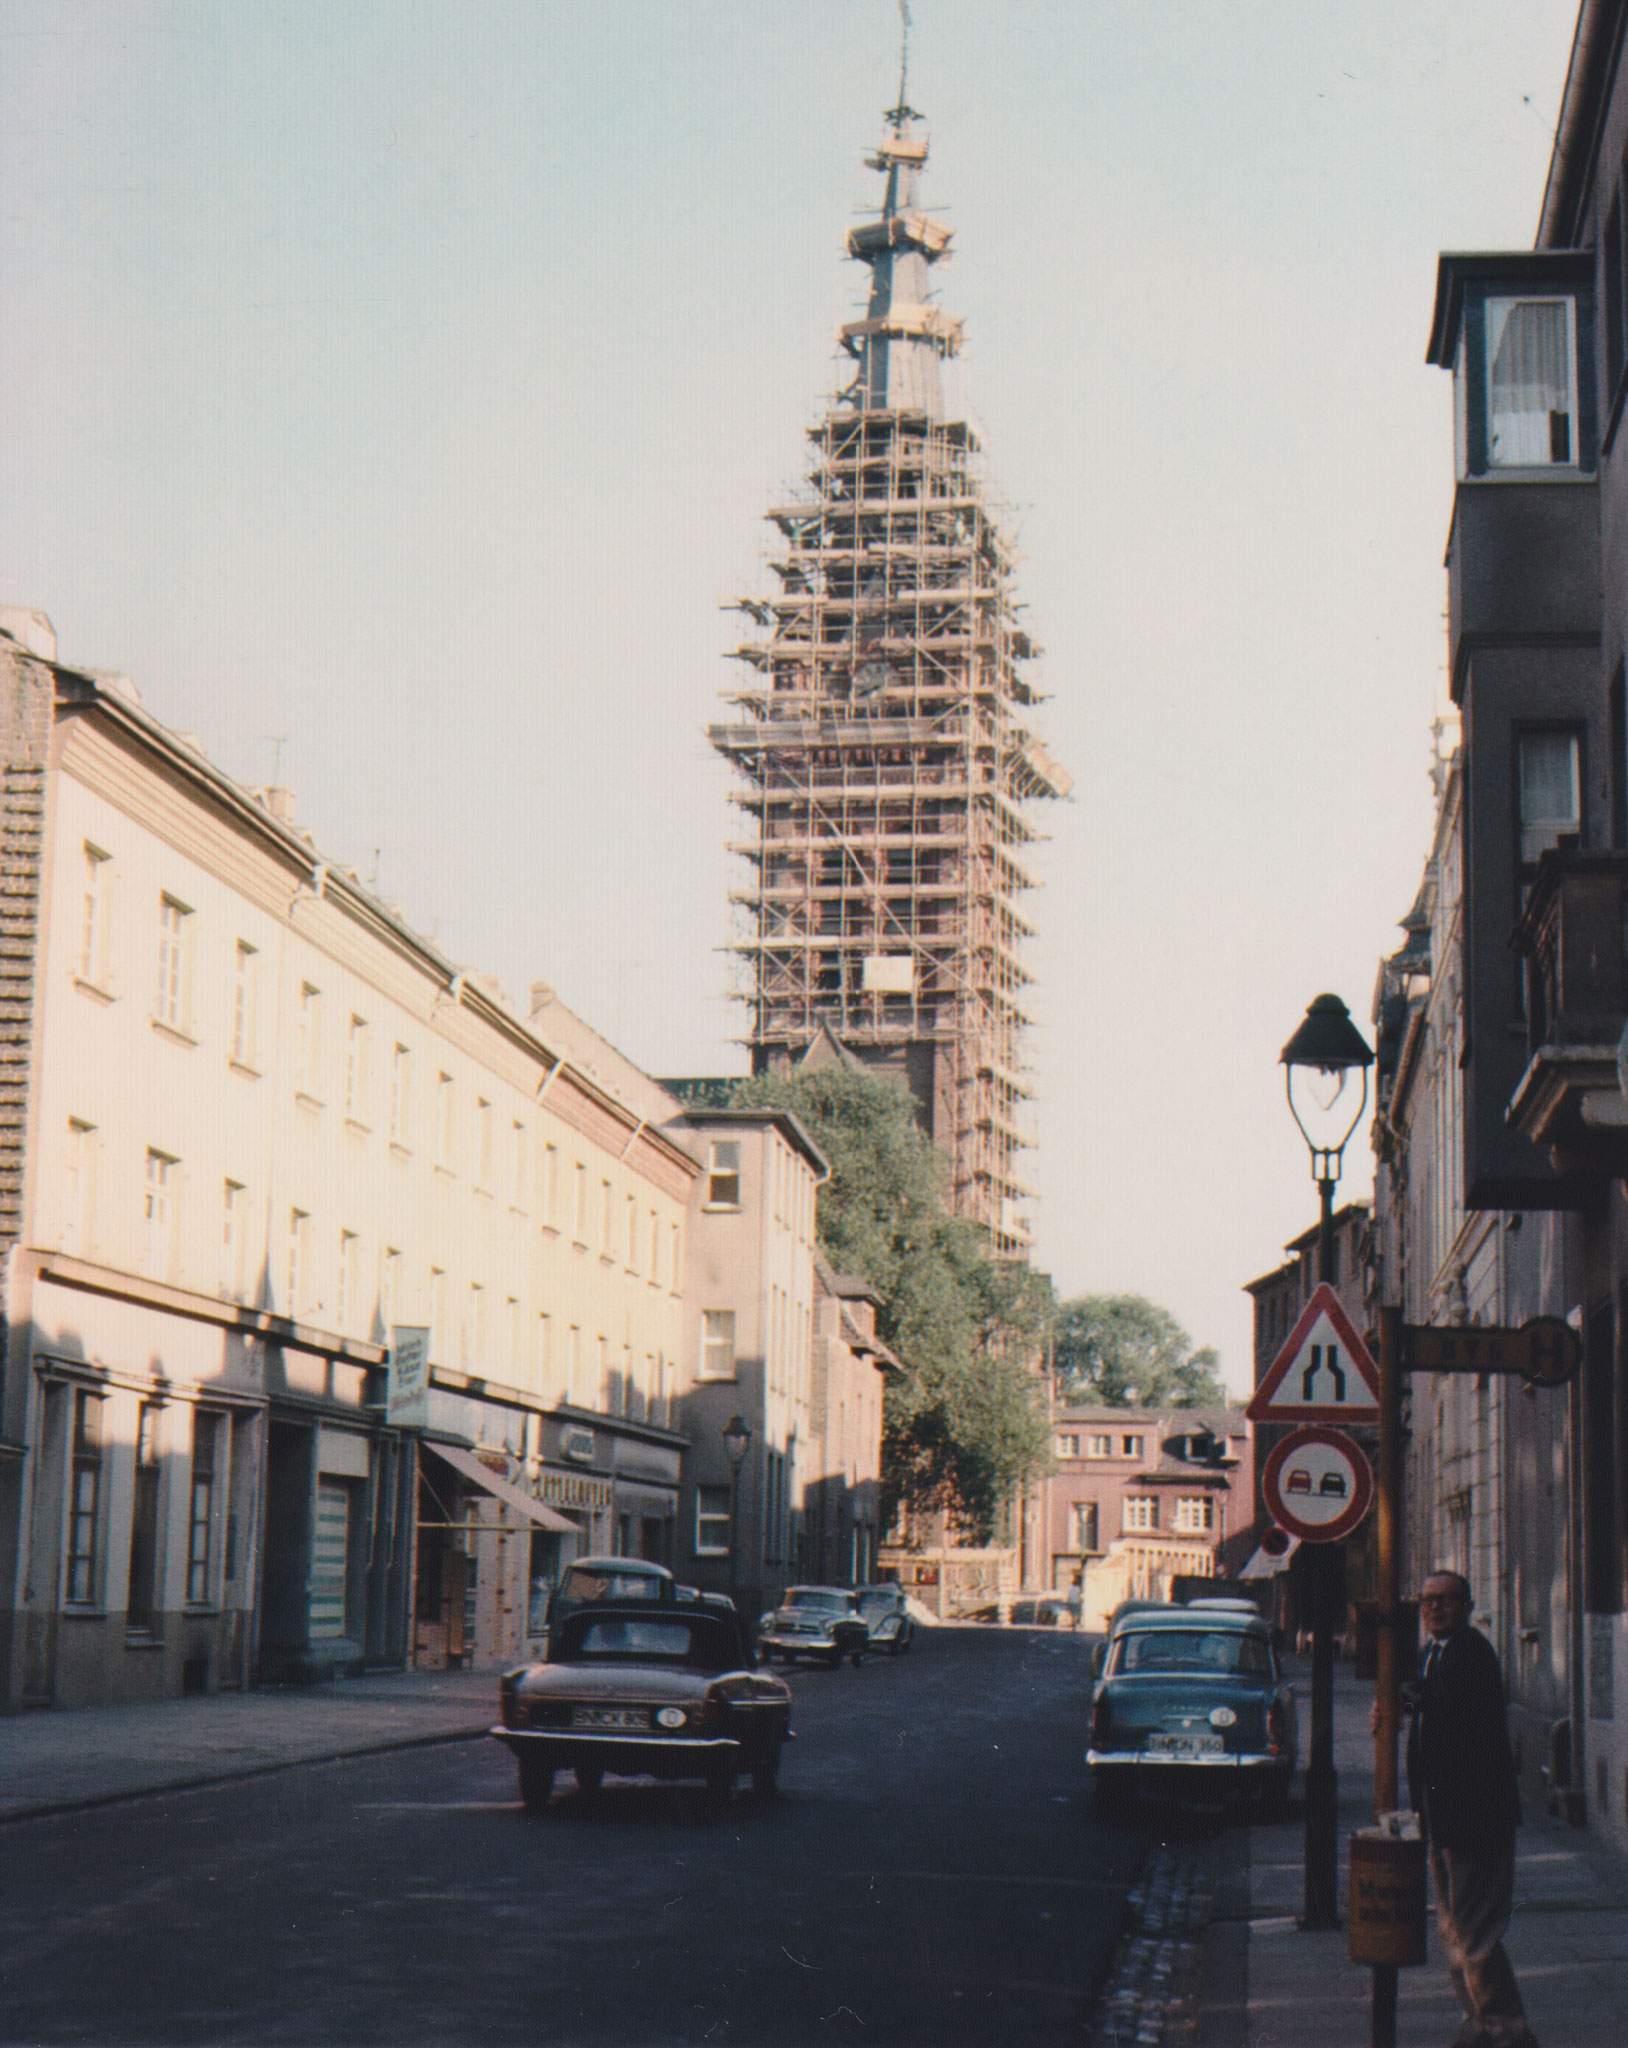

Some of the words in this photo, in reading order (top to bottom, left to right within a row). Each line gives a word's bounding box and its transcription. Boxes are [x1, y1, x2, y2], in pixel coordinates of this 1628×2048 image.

[1440, 1337, 1503, 1361] BVG
[1529, 1331, 1565, 1371] H
[666, 1709, 679, 1724] D
